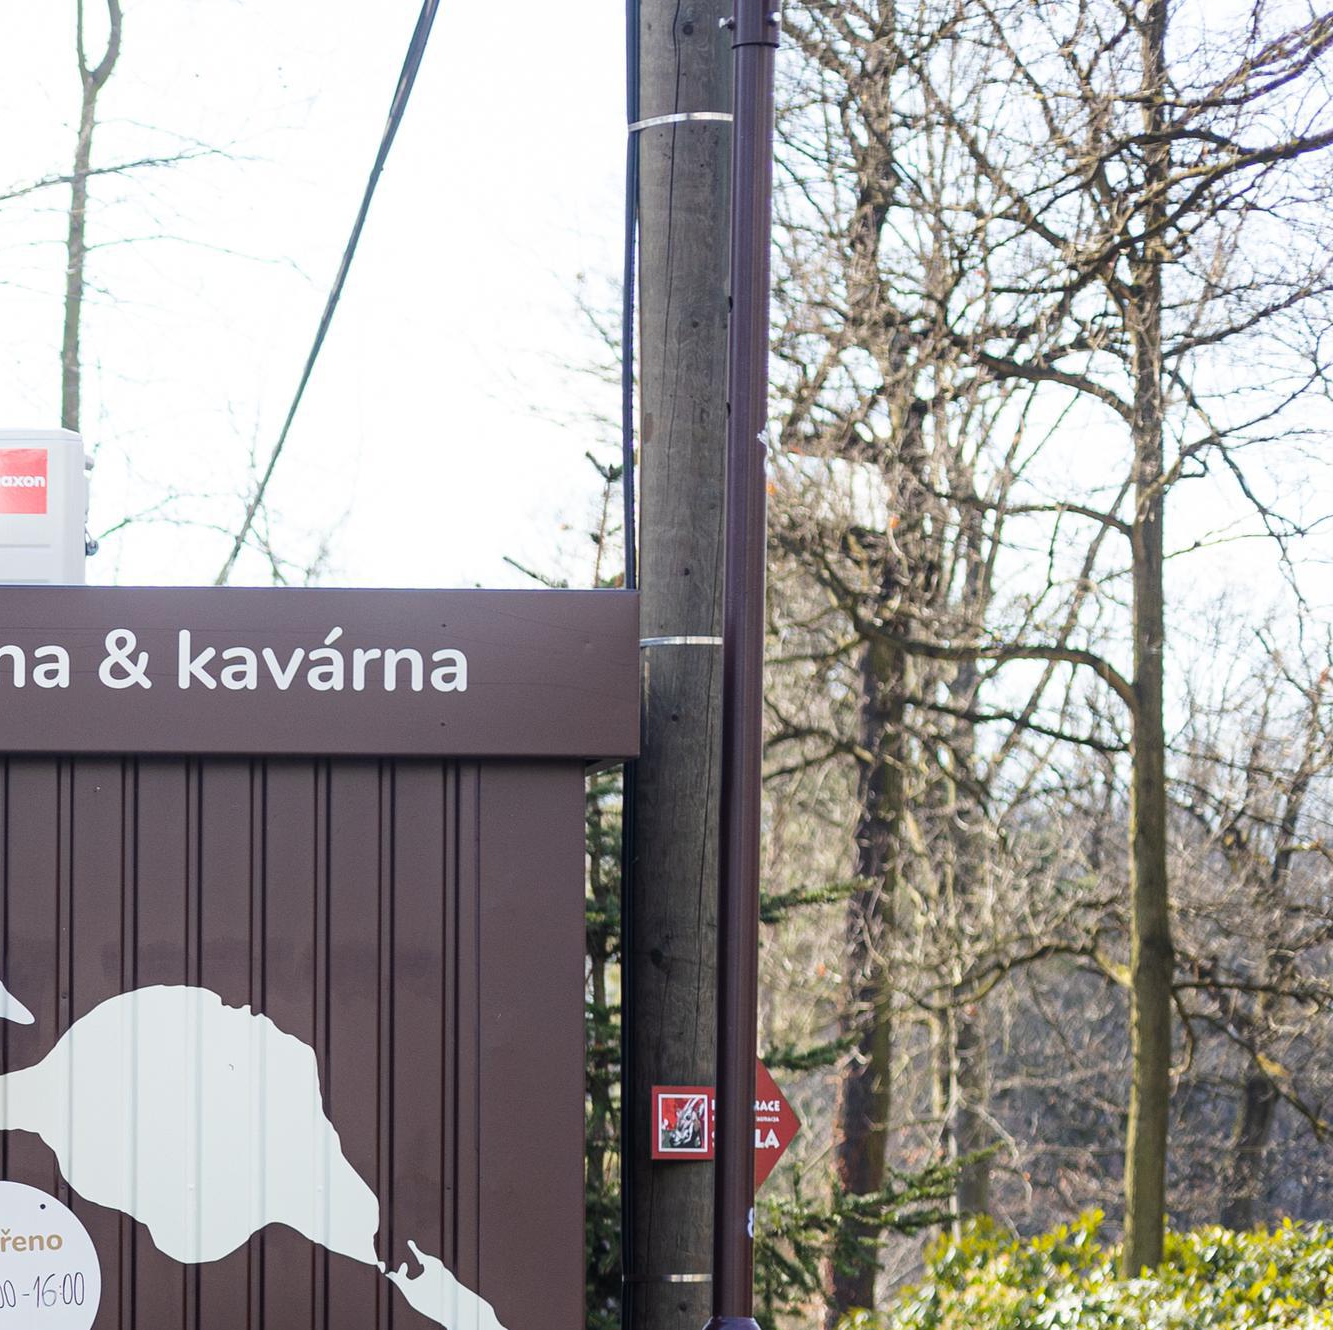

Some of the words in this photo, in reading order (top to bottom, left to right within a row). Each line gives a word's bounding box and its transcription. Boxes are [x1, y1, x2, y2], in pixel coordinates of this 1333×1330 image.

[97, 630, 153, 689] &
[175, 626, 471, 693] kavárna
[33, 1271, 85, 1308] 16:00
